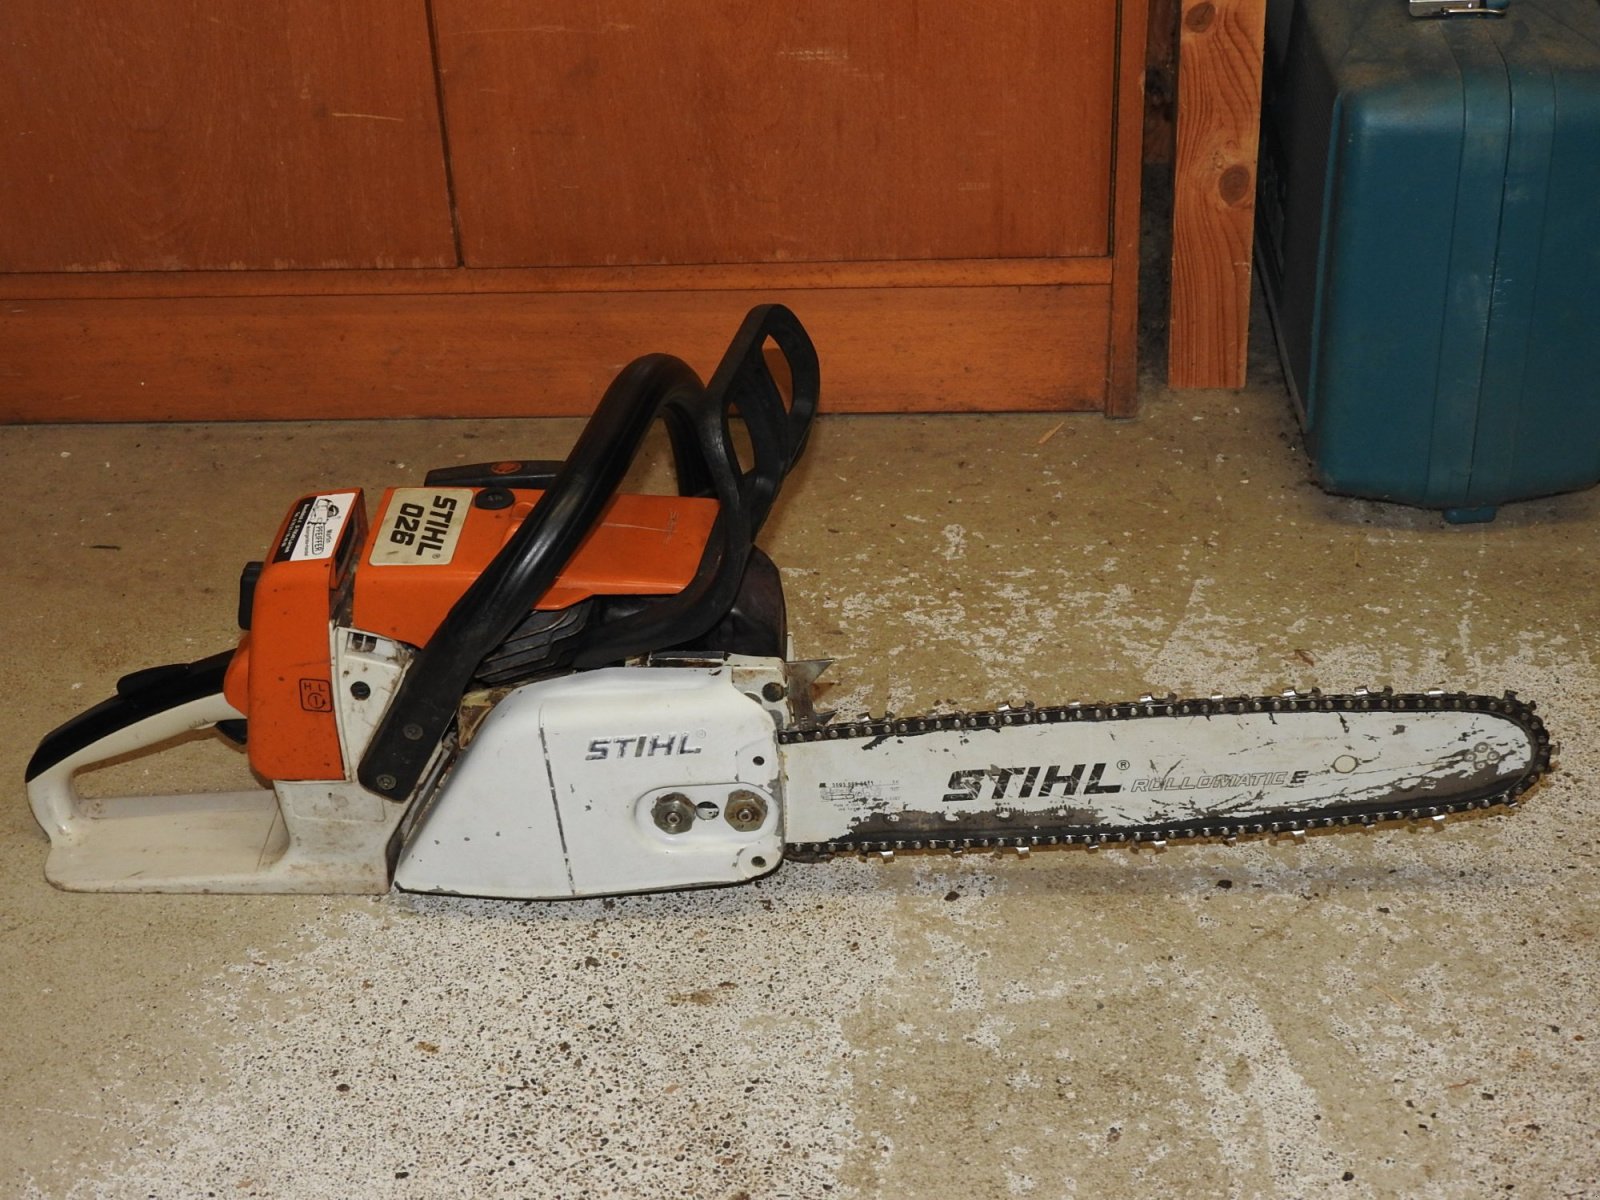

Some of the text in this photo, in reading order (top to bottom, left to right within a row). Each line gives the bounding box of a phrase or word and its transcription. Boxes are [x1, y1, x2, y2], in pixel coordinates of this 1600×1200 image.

[314, 526, 324, 552] PFEIFFER
[390, 503, 425, 546] 026
[416, 495, 457, 556] STIHL
[585, 734, 702, 761] STIHL
[942, 763, 1122, 801] STIHL
